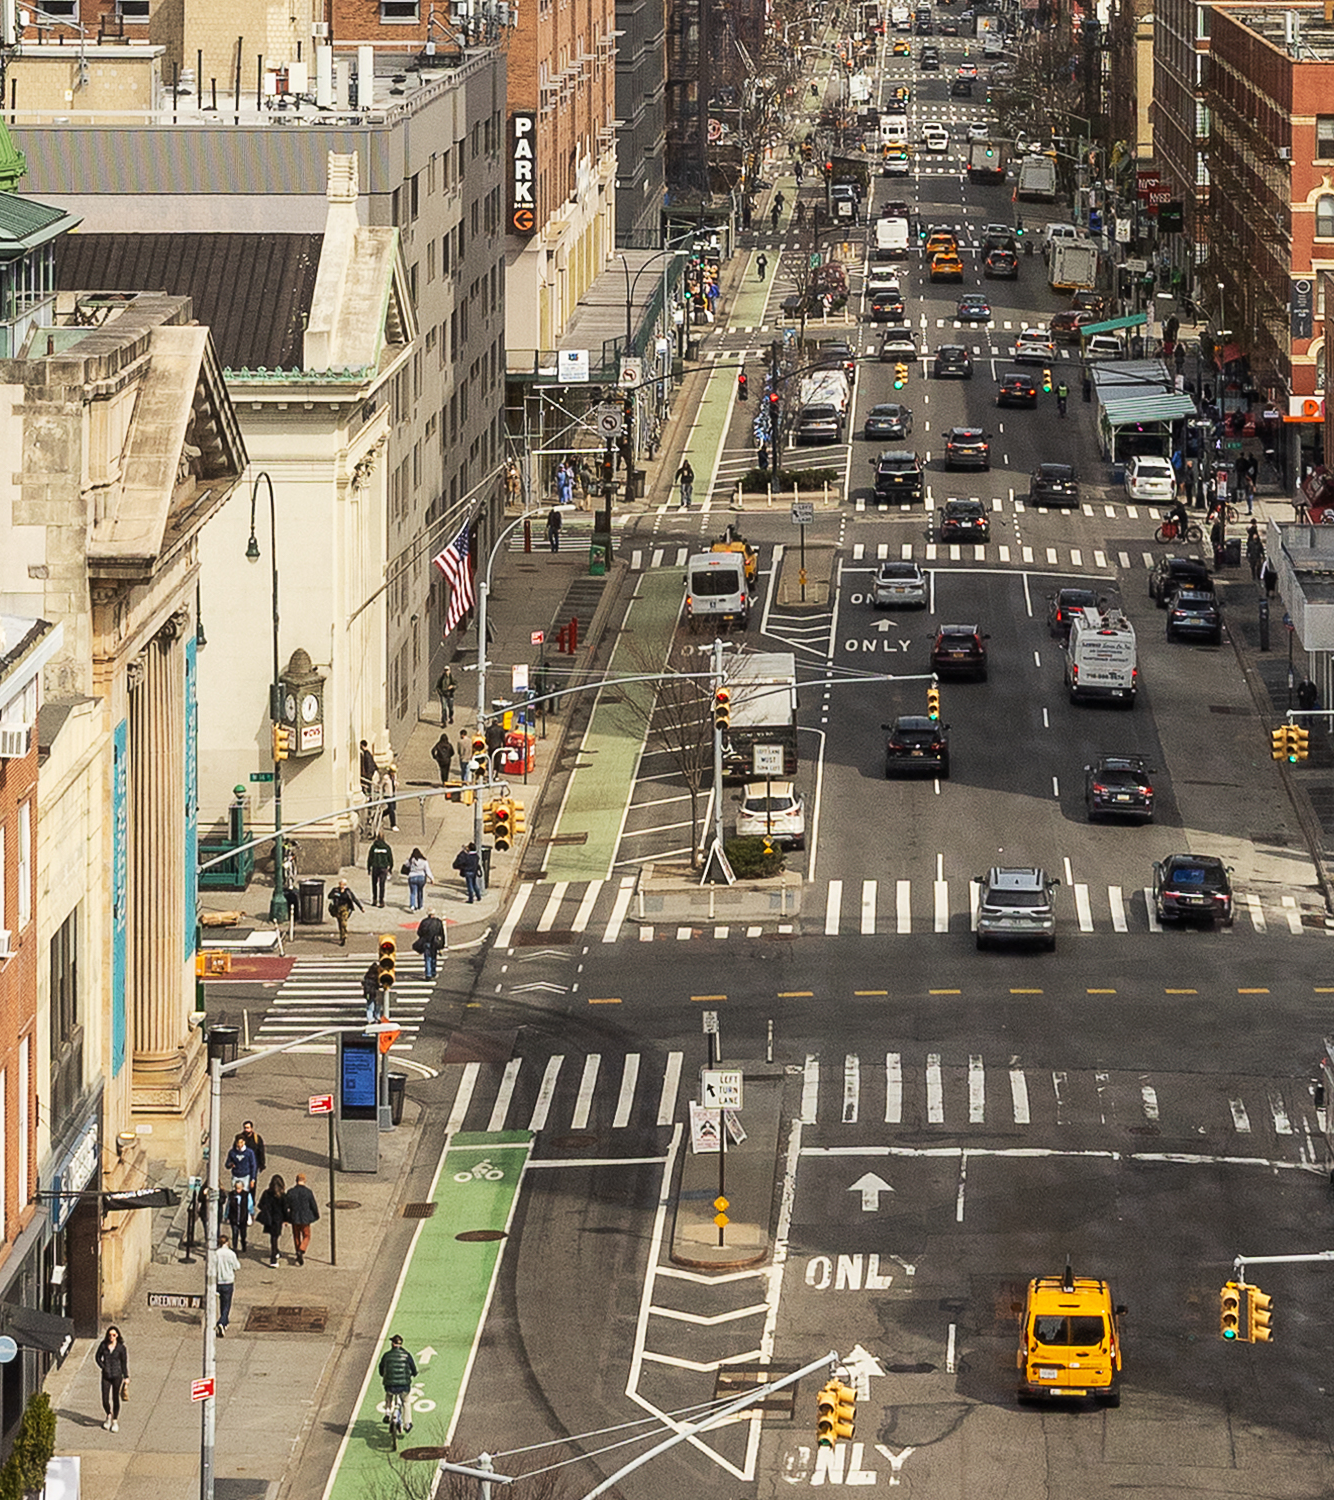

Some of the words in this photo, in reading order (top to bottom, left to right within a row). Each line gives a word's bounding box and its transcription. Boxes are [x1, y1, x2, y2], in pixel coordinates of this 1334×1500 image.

[514, 117, 533, 202] PARK
[845, 639, 911, 652] ONLY
[720, 1076, 738, 1084] LEFT
[719, 1086, 738, 1094] TURN
[719, 1097, 738, 1105] LANE
[150, 1294, 189, 1308] GREENWICH
[191, 1296, 202, 1308] AV
[782, 1443, 917, 1486] ONLY
